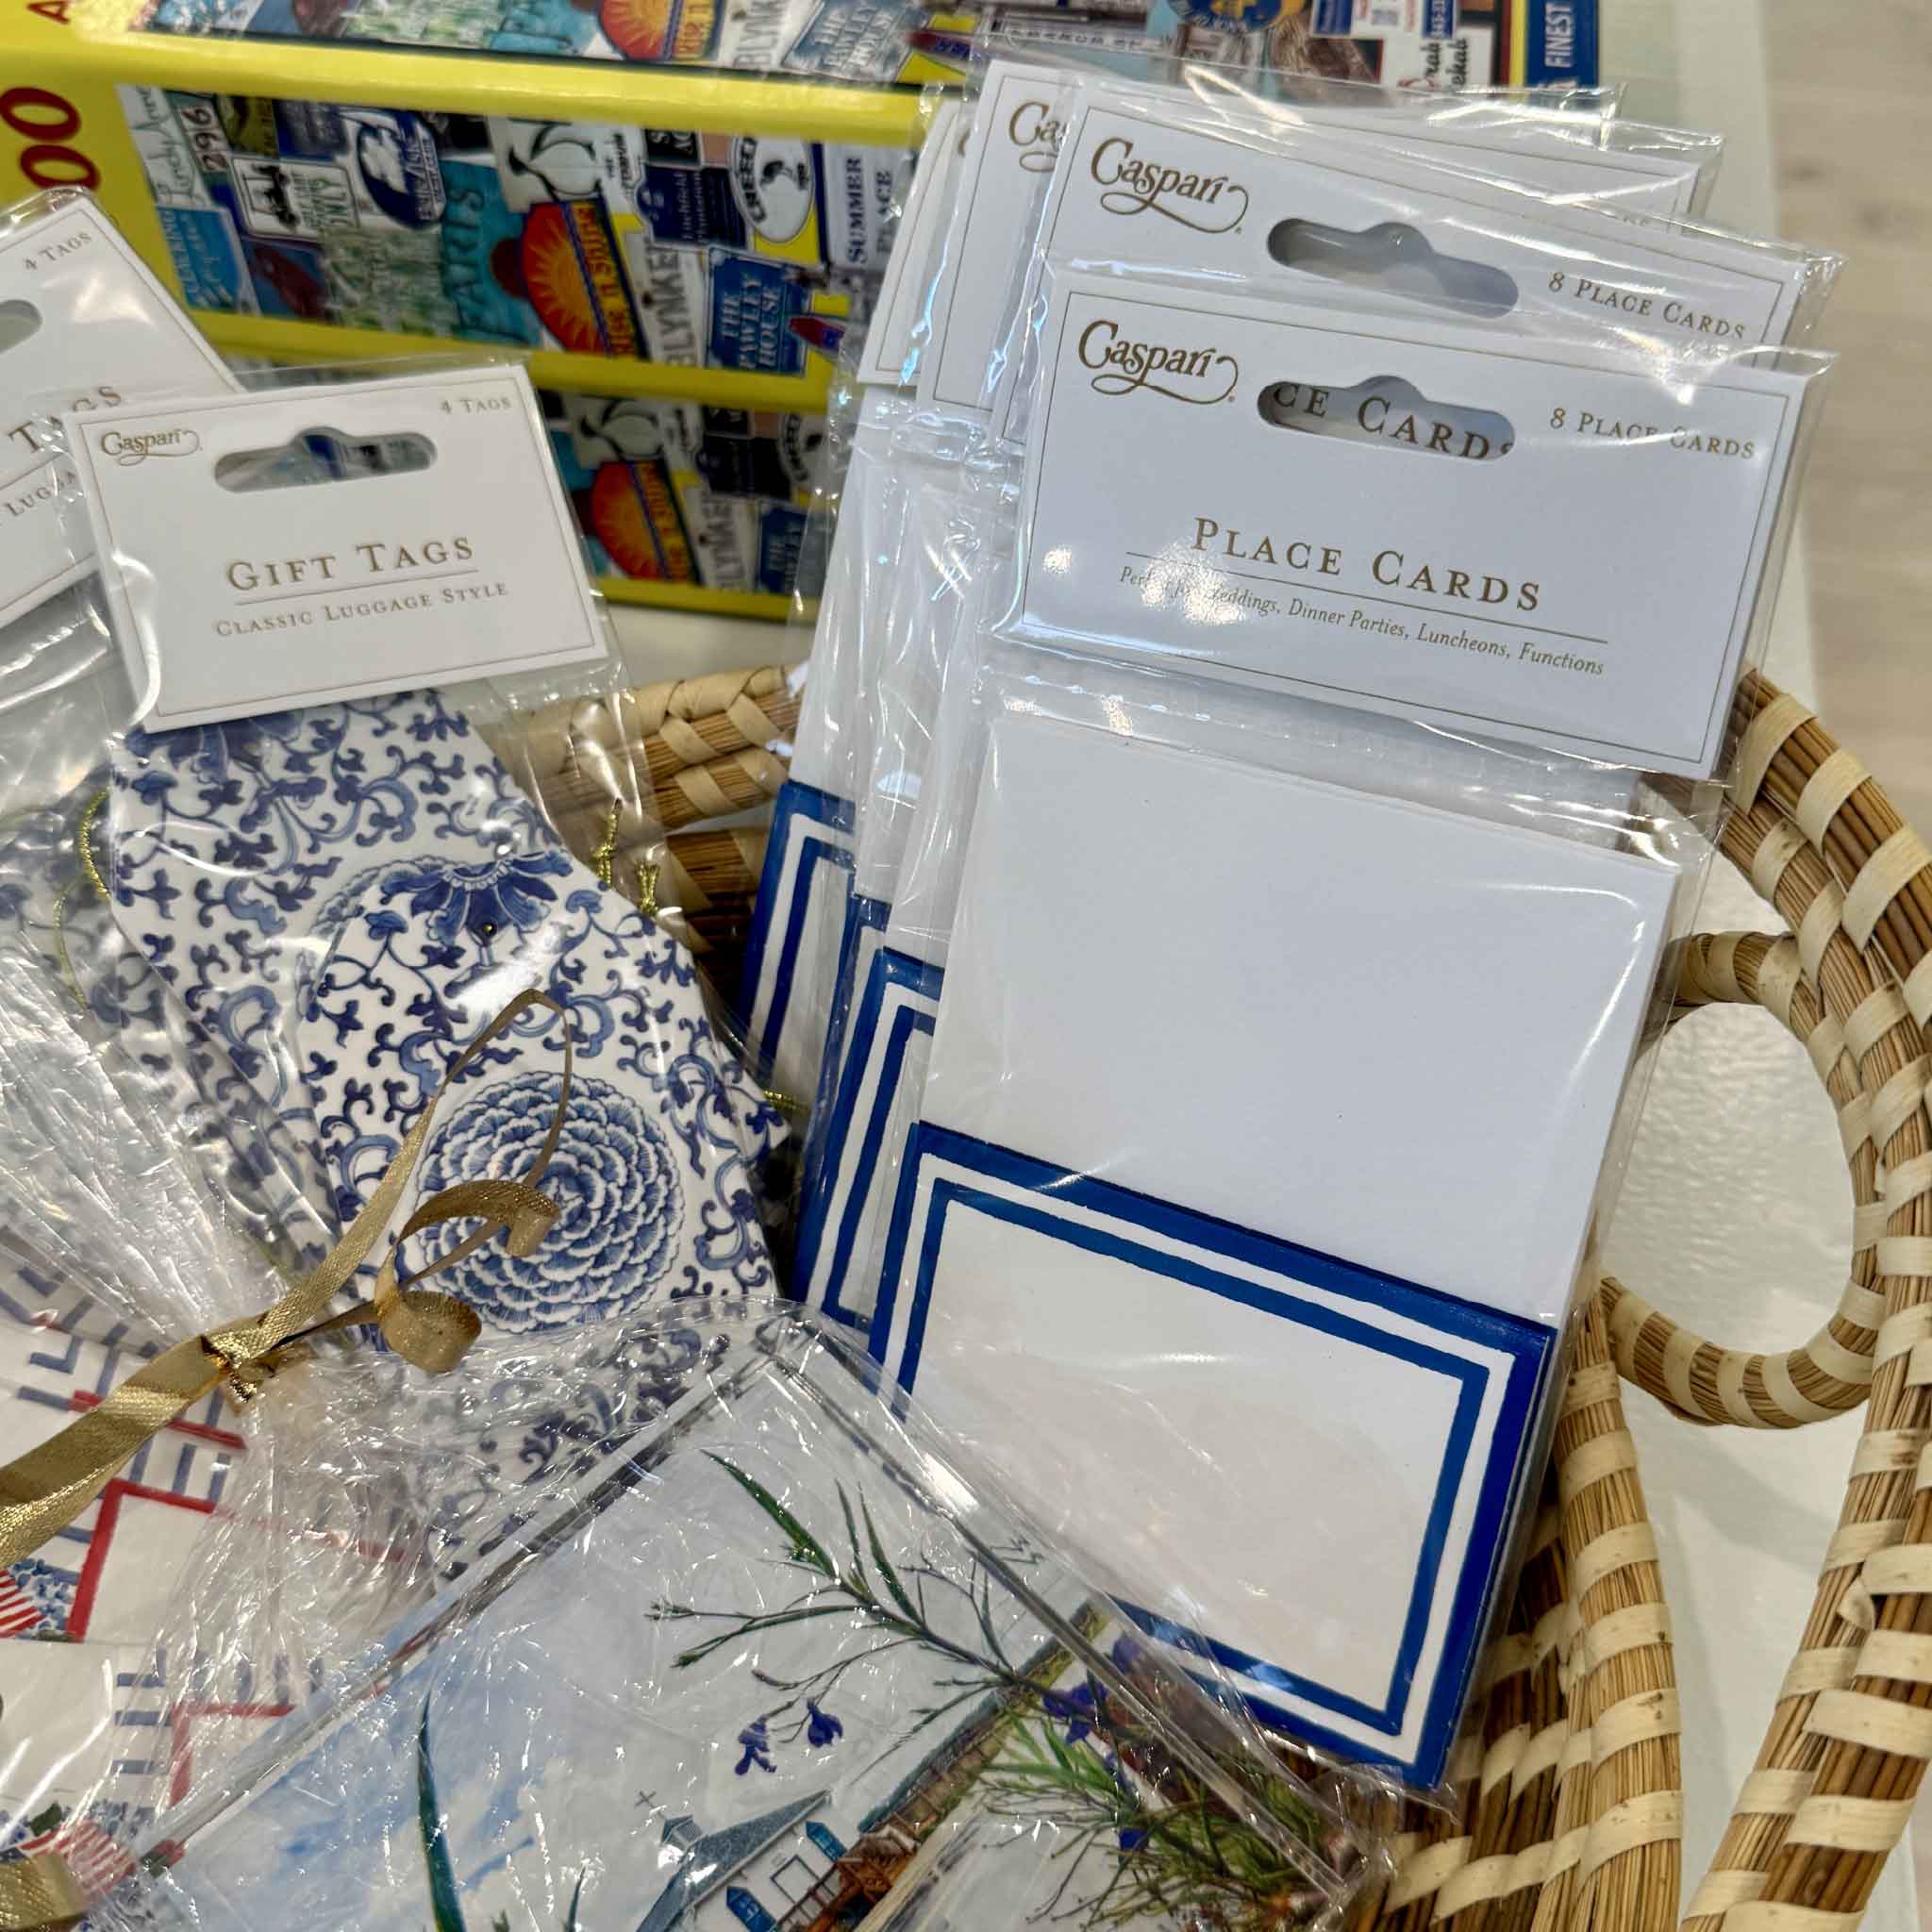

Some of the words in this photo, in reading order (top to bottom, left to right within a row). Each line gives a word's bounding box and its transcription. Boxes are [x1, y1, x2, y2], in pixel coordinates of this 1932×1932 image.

[1544, 3, 1574, 68] FINEST
[181, 108, 227, 173] 296
[846, 158, 867, 264] SUMMER
[1091, 137, 1249, 234] Caspari
[25, 258, 38, 271] 4
[38, 232, 92, 261] TAGS
[721, 291, 741, 338] THE
[759, 286, 779, 366] HOUSE
[1548, 272, 1564, 293] 8
[1574, 278, 1653, 317] PLACE
[1662, 302, 1745, 340] CARDS
[1078, 319, 1238, 405] Caspari
[441, 400, 454, 413] 4
[460, 395, 512, 413] TAGS
[1550, 408, 1566, 429] 8
[1669, 426, 1756, 459] CARDS
[101, 428, 200, 466] Caspari
[227, 553, 337, 592] GIFT
[356, 537, 475, 574] TAGS
[1190, 516, 1343, 577] PLACE
[1372, 549, 1541, 612] CARDS
[216, 609, 314, 638] CLASSIC
[326, 593, 433, 623] LUGGAGE
[441, 581, 508, 608] STYLE
[1289, 598, 1346, 626] Dinner
[1347, 610, 1409, 641] Parties,
[1417, 623, 1511, 659] Luncheons,
[1518, 642, 1605, 676] Functions
